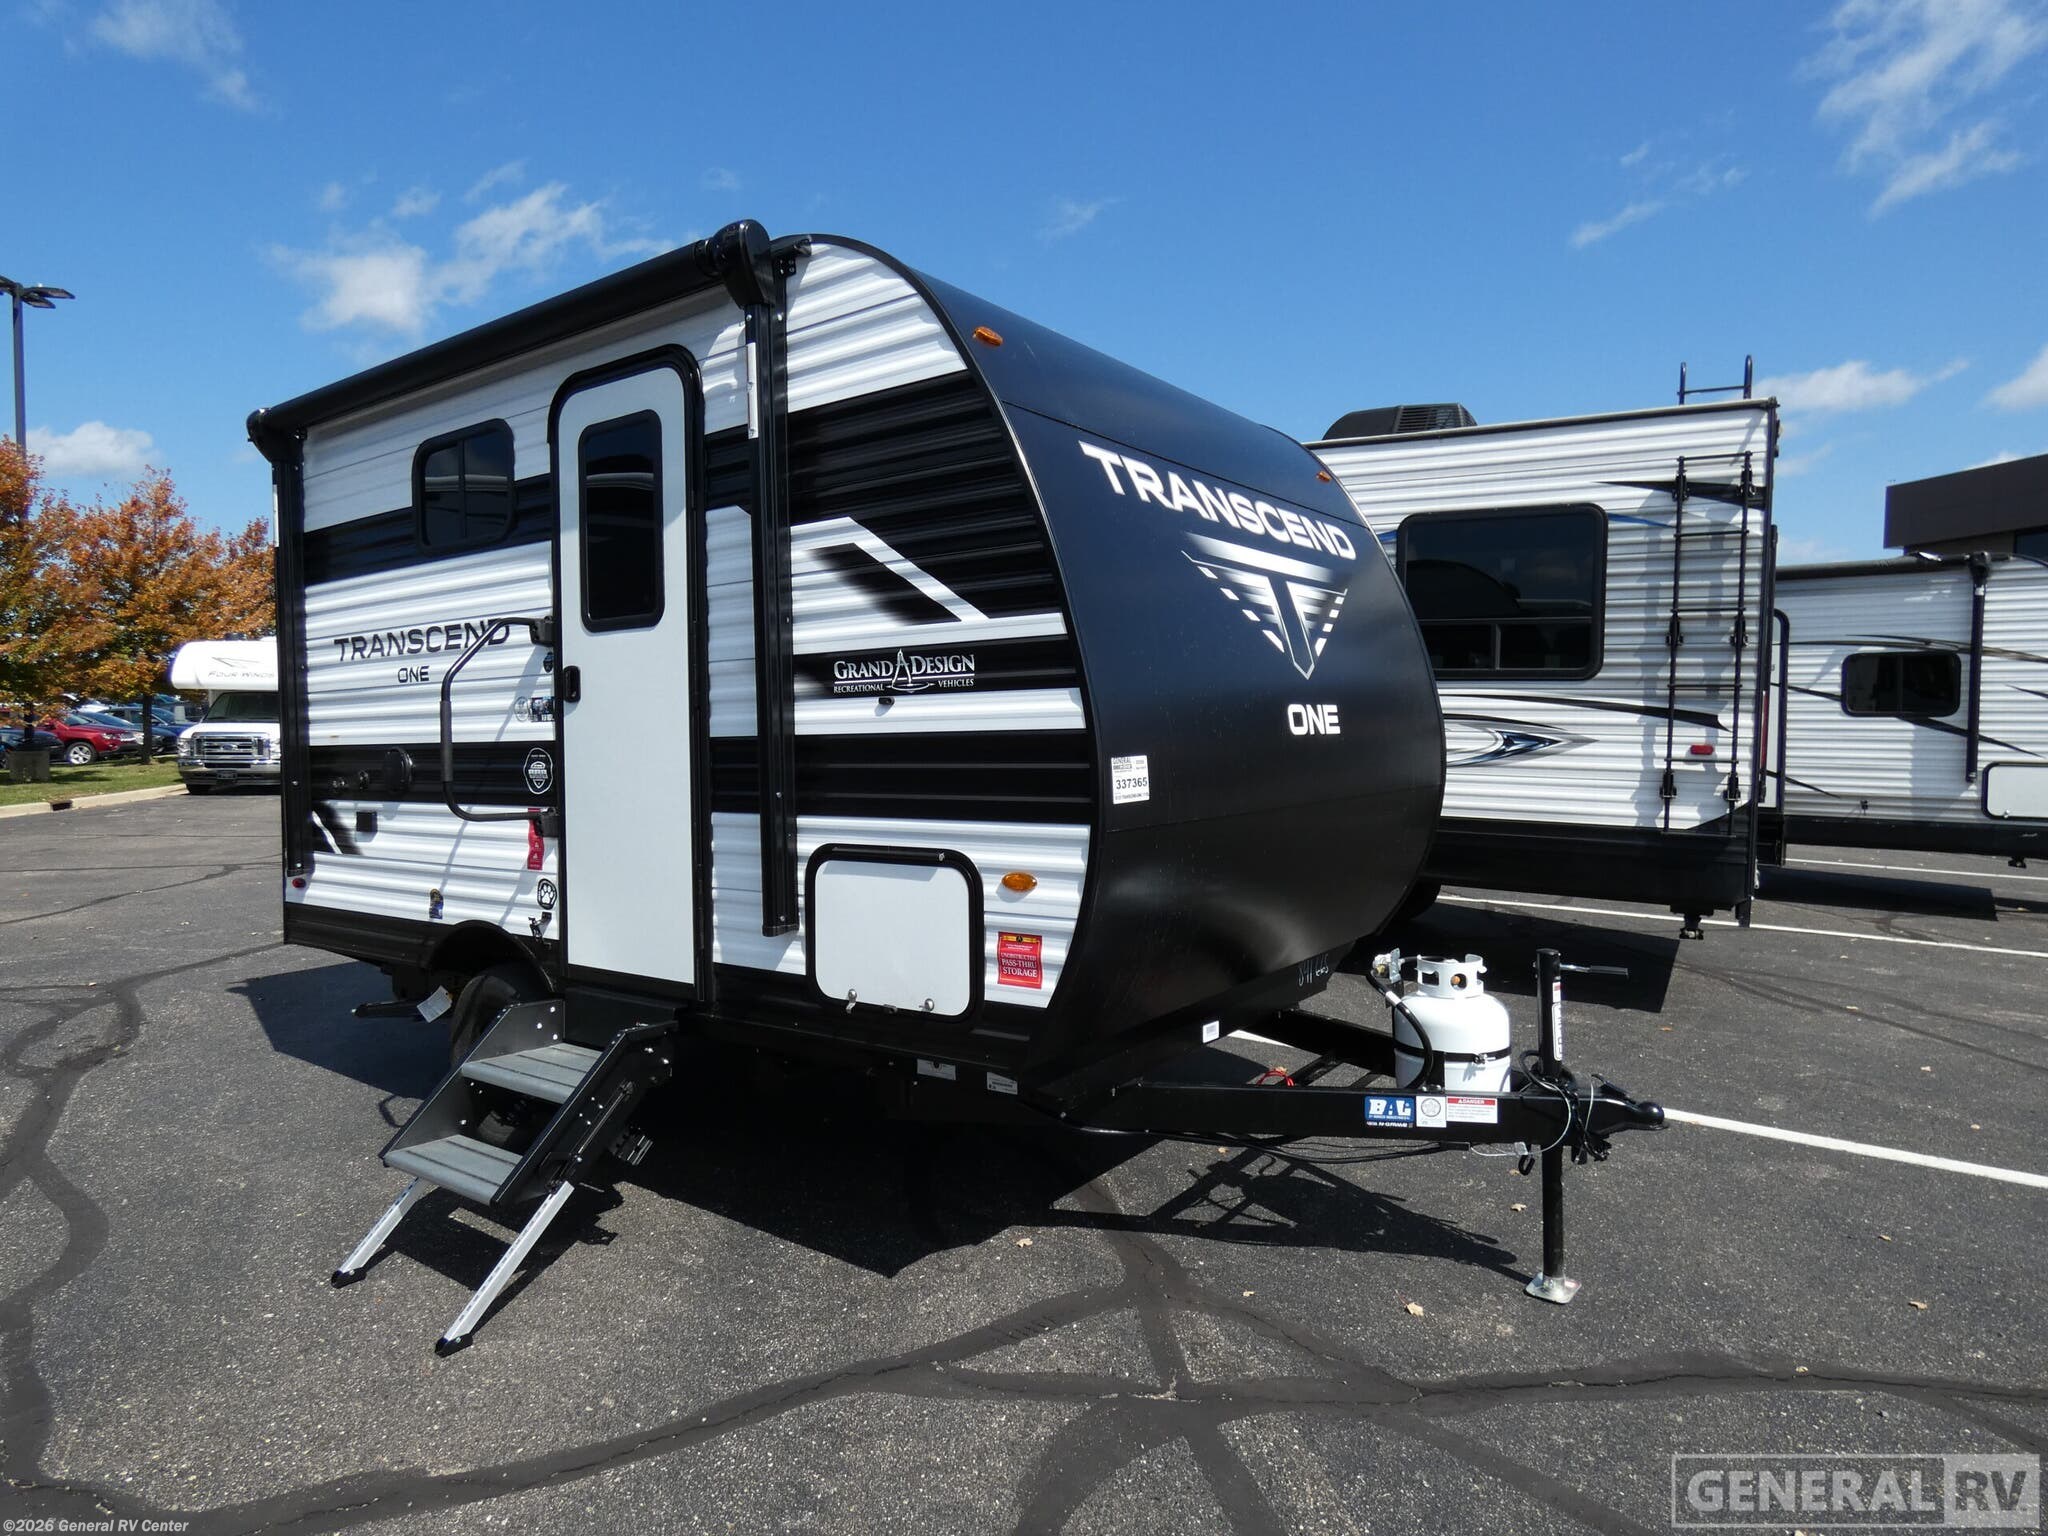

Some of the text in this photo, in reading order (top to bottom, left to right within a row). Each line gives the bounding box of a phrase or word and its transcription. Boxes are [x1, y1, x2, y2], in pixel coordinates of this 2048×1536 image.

[1078, 440, 1356, 560] TRANSCEND
[333, 618, 510, 662] TRANSCEND
[397, 665, 430, 684] ONE
[833, 654, 975, 680] GRAND DESIGN
[833, 678, 975, 694] RECREATIONAL VEHICLES
[1287, 703, 1342, 736] ONE
[1115, 776, 1148, 790] 337365
[1001, 958, 1037, 969] PASS-THRU
[1002, 966, 1038, 978] STORAGE
[1369, 1098, 1412, 1116] BAL
